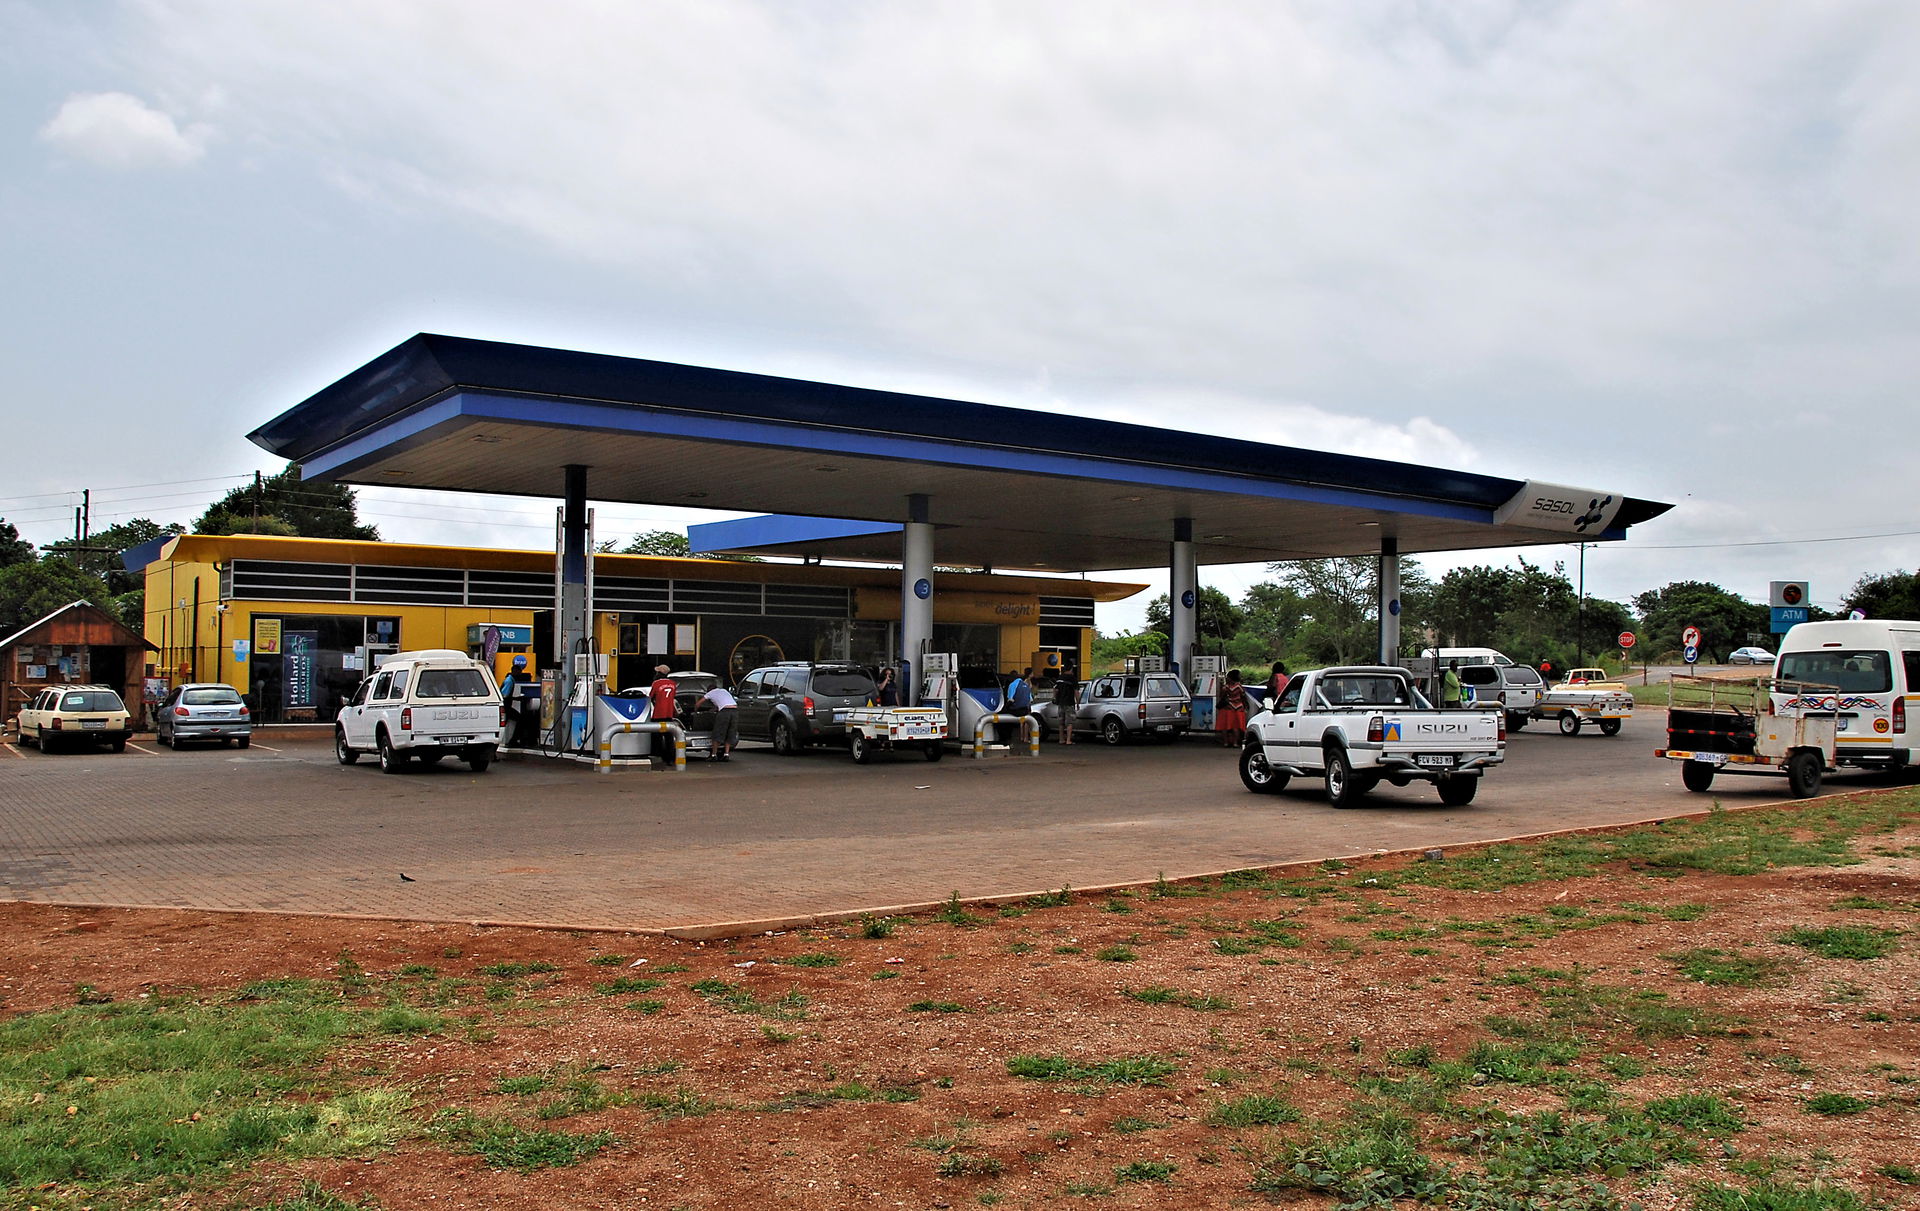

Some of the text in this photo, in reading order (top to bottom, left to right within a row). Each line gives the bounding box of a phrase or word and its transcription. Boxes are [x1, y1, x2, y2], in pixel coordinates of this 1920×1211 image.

[1532, 498, 1575, 514] sasol
[921, 583, 929, 594] 3
[1782, 609, 1803, 620] ATM
[290, 655, 299, 705] Hollard
[664, 688, 672, 698] 7
[433, 710, 480, 720] ISUZU
[1417, 723, 1468, 734] ISUZU
